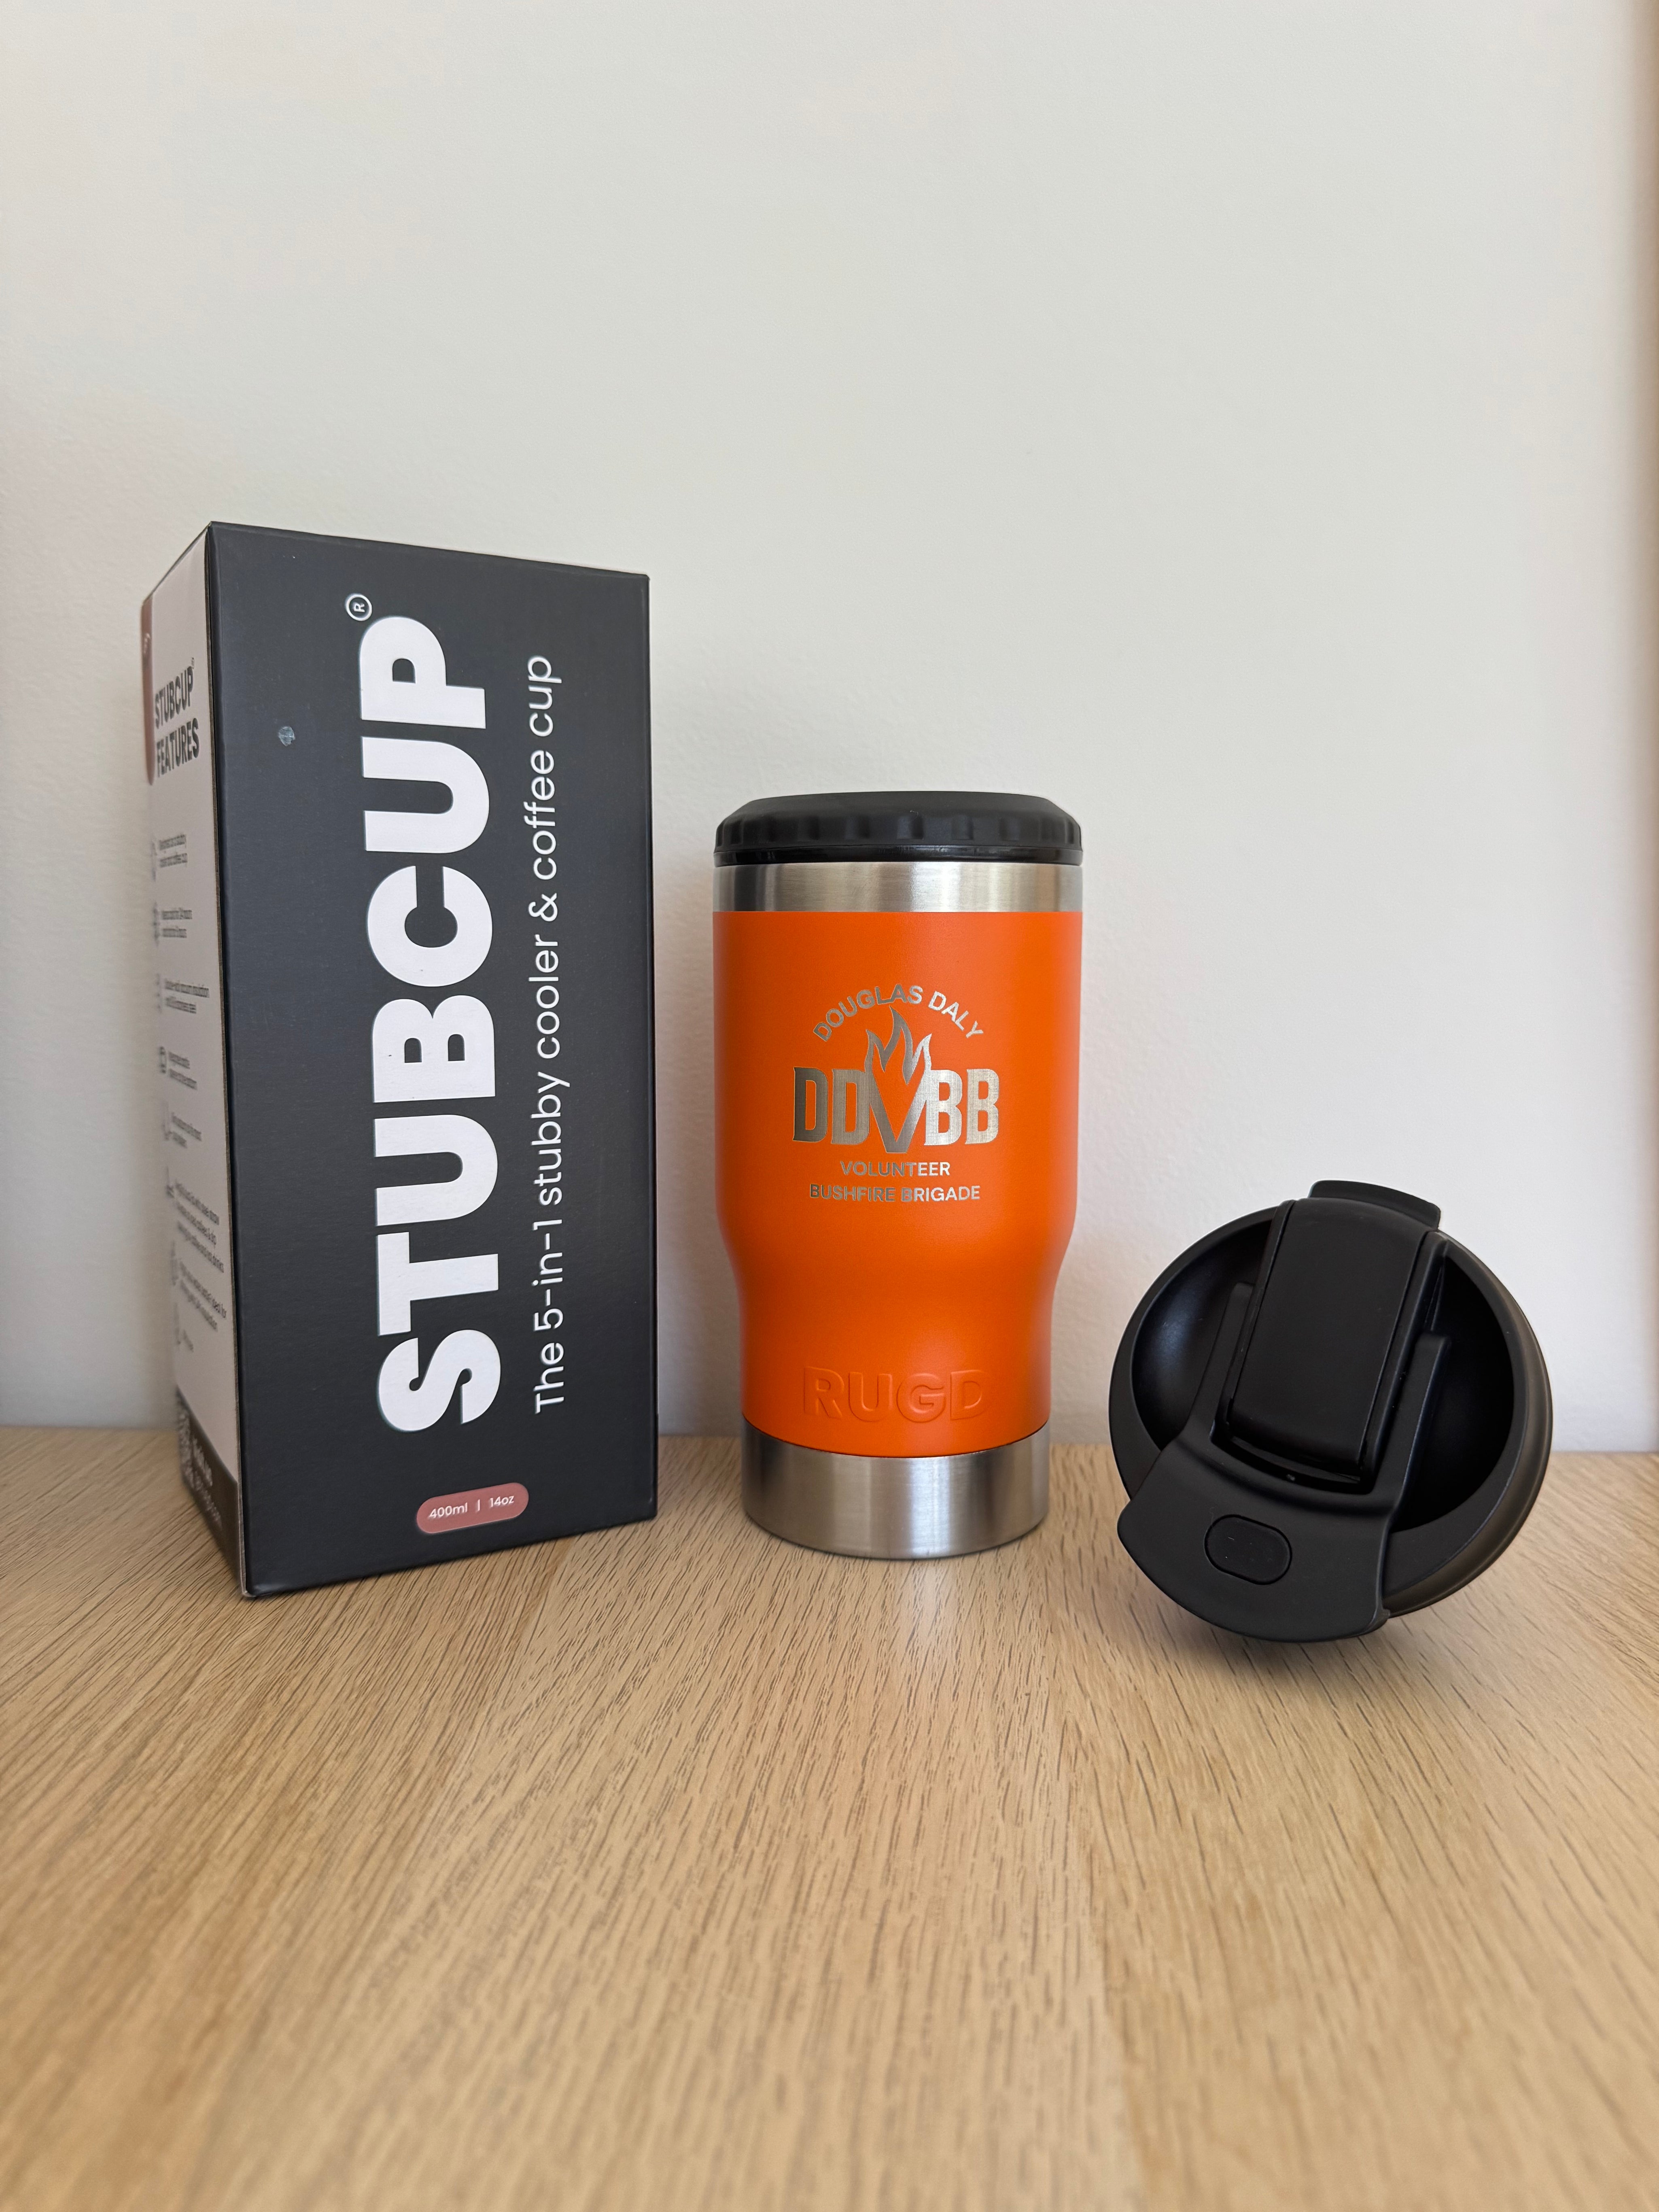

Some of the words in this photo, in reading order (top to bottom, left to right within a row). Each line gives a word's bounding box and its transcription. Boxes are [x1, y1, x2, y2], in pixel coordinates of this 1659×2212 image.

[527, 656, 562, 737] cup
[156, 718, 199, 778] FEATURES
[523, 750, 557, 880] coffee
[528, 893, 558, 921] &
[528, 950, 560, 1059] cooler
[813, 984, 923, 1042] DOUGLAS
[928, 991, 984, 1039] DALY
[530, 1072, 570, 1206] stubby
[840, 1161, 950, 1176] VOLUNTEER
[810, 1183, 895, 1202] BUSHFIRE
[901, 1185, 980, 1202] BRIGADE
[532, 1219, 563, 1331] 5-in-1
[534, 1343, 564, 1414] The
[804, 1366, 987, 1423] RUGD
[428, 1502, 468, 1518] 400ml
[489, 1495, 515, 1508] 14oz
